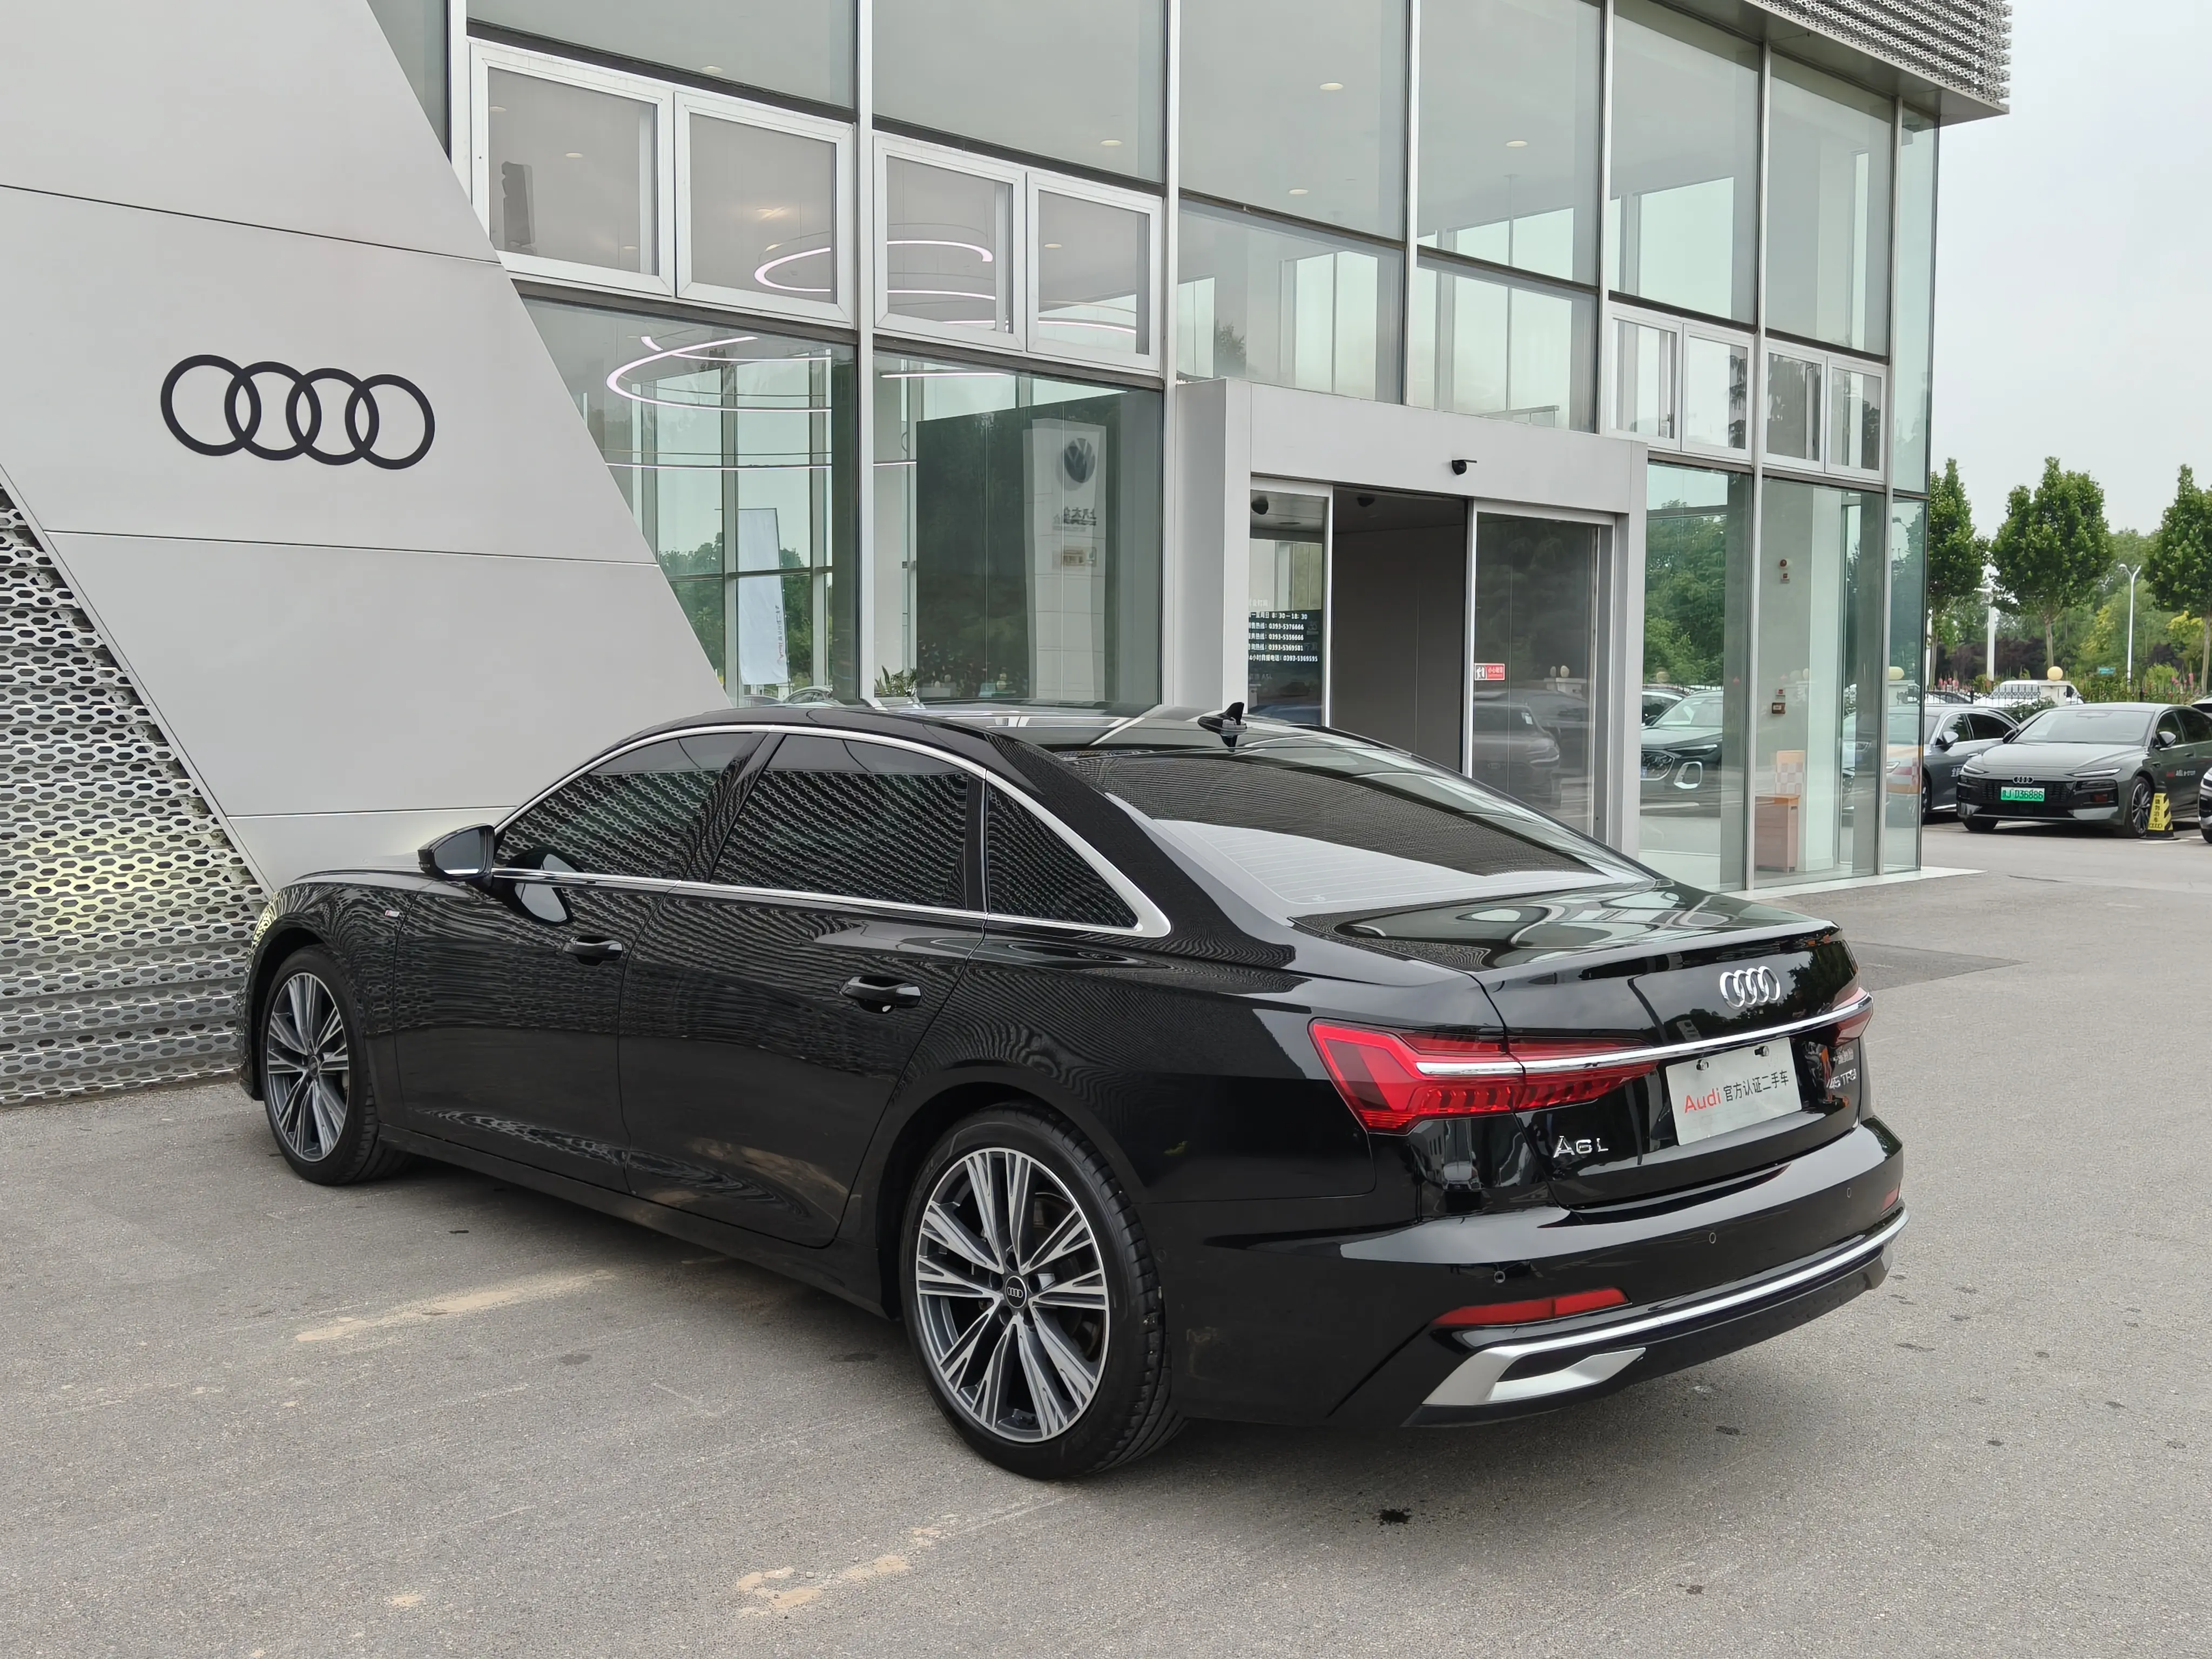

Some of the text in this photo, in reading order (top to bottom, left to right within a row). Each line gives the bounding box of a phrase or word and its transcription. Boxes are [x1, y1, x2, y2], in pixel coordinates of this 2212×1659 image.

[1684, 1070, 1789, 1114] Audi 官方认证二手车
[1553, 1135, 1609, 1158] A6L
